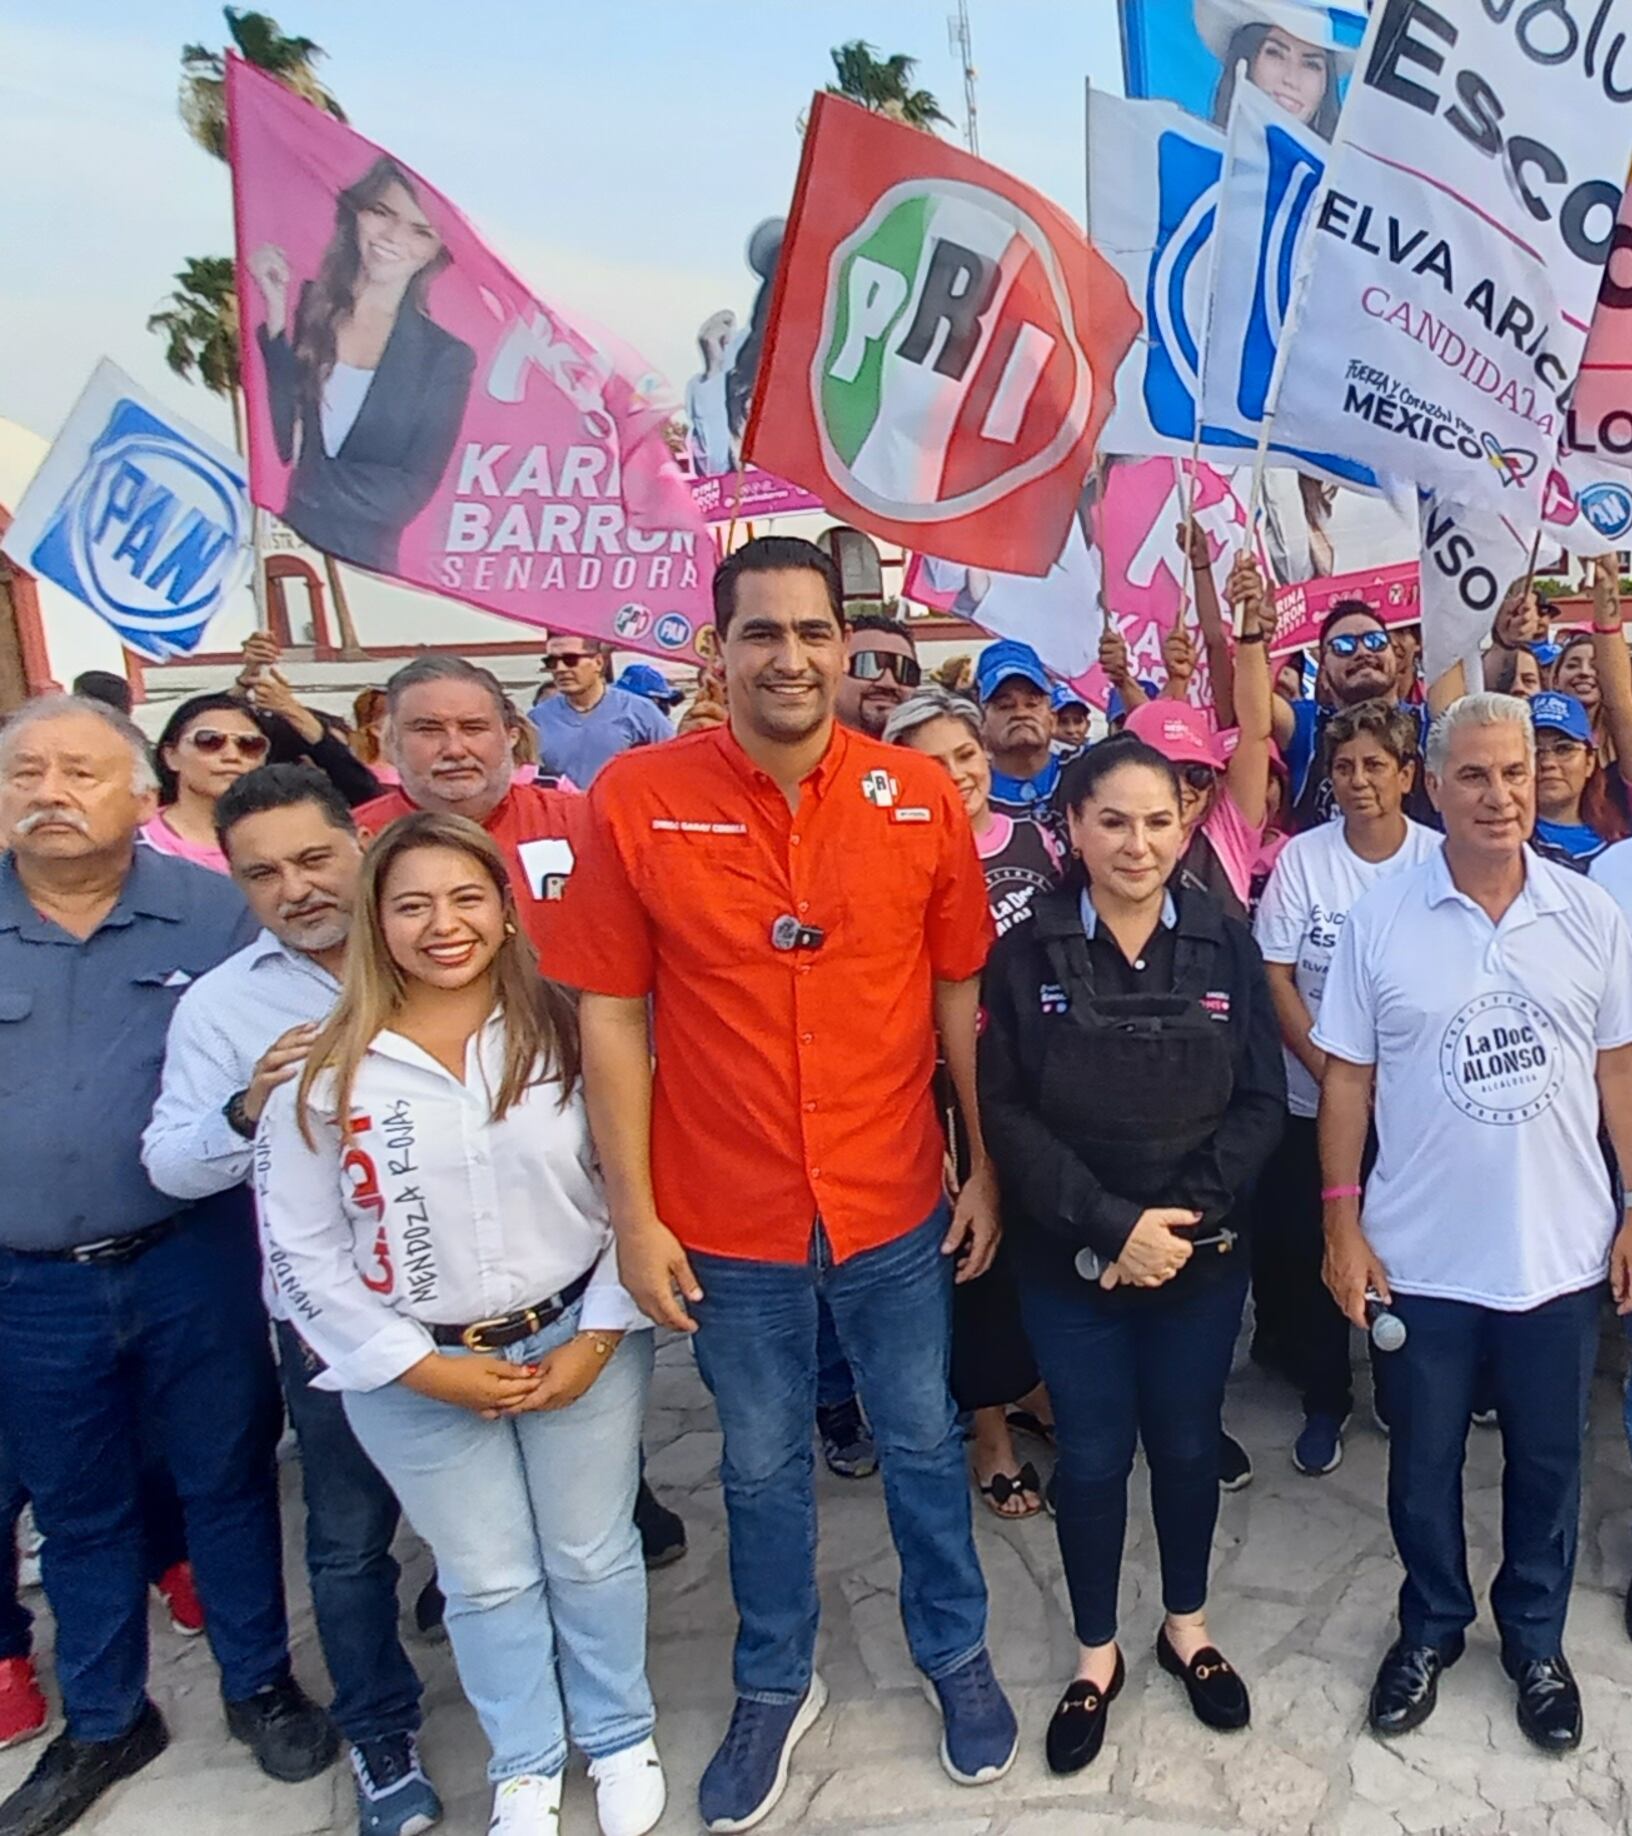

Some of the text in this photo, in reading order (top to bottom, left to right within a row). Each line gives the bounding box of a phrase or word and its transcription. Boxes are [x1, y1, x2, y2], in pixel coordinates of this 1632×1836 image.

[1317, 190, 1453, 294] ELVA
[829, 237, 1056, 444] PRI
[94, 460, 233, 605] PAN
[440, 555, 698, 592] SENADORA
[861, 775, 898, 799] PRI
[1463, 1045, 1547, 1085] ALONSO
[1465, 1025, 1534, 1057] La Doc
[381, 1098, 438, 1305] MENDOZA ROJAS
